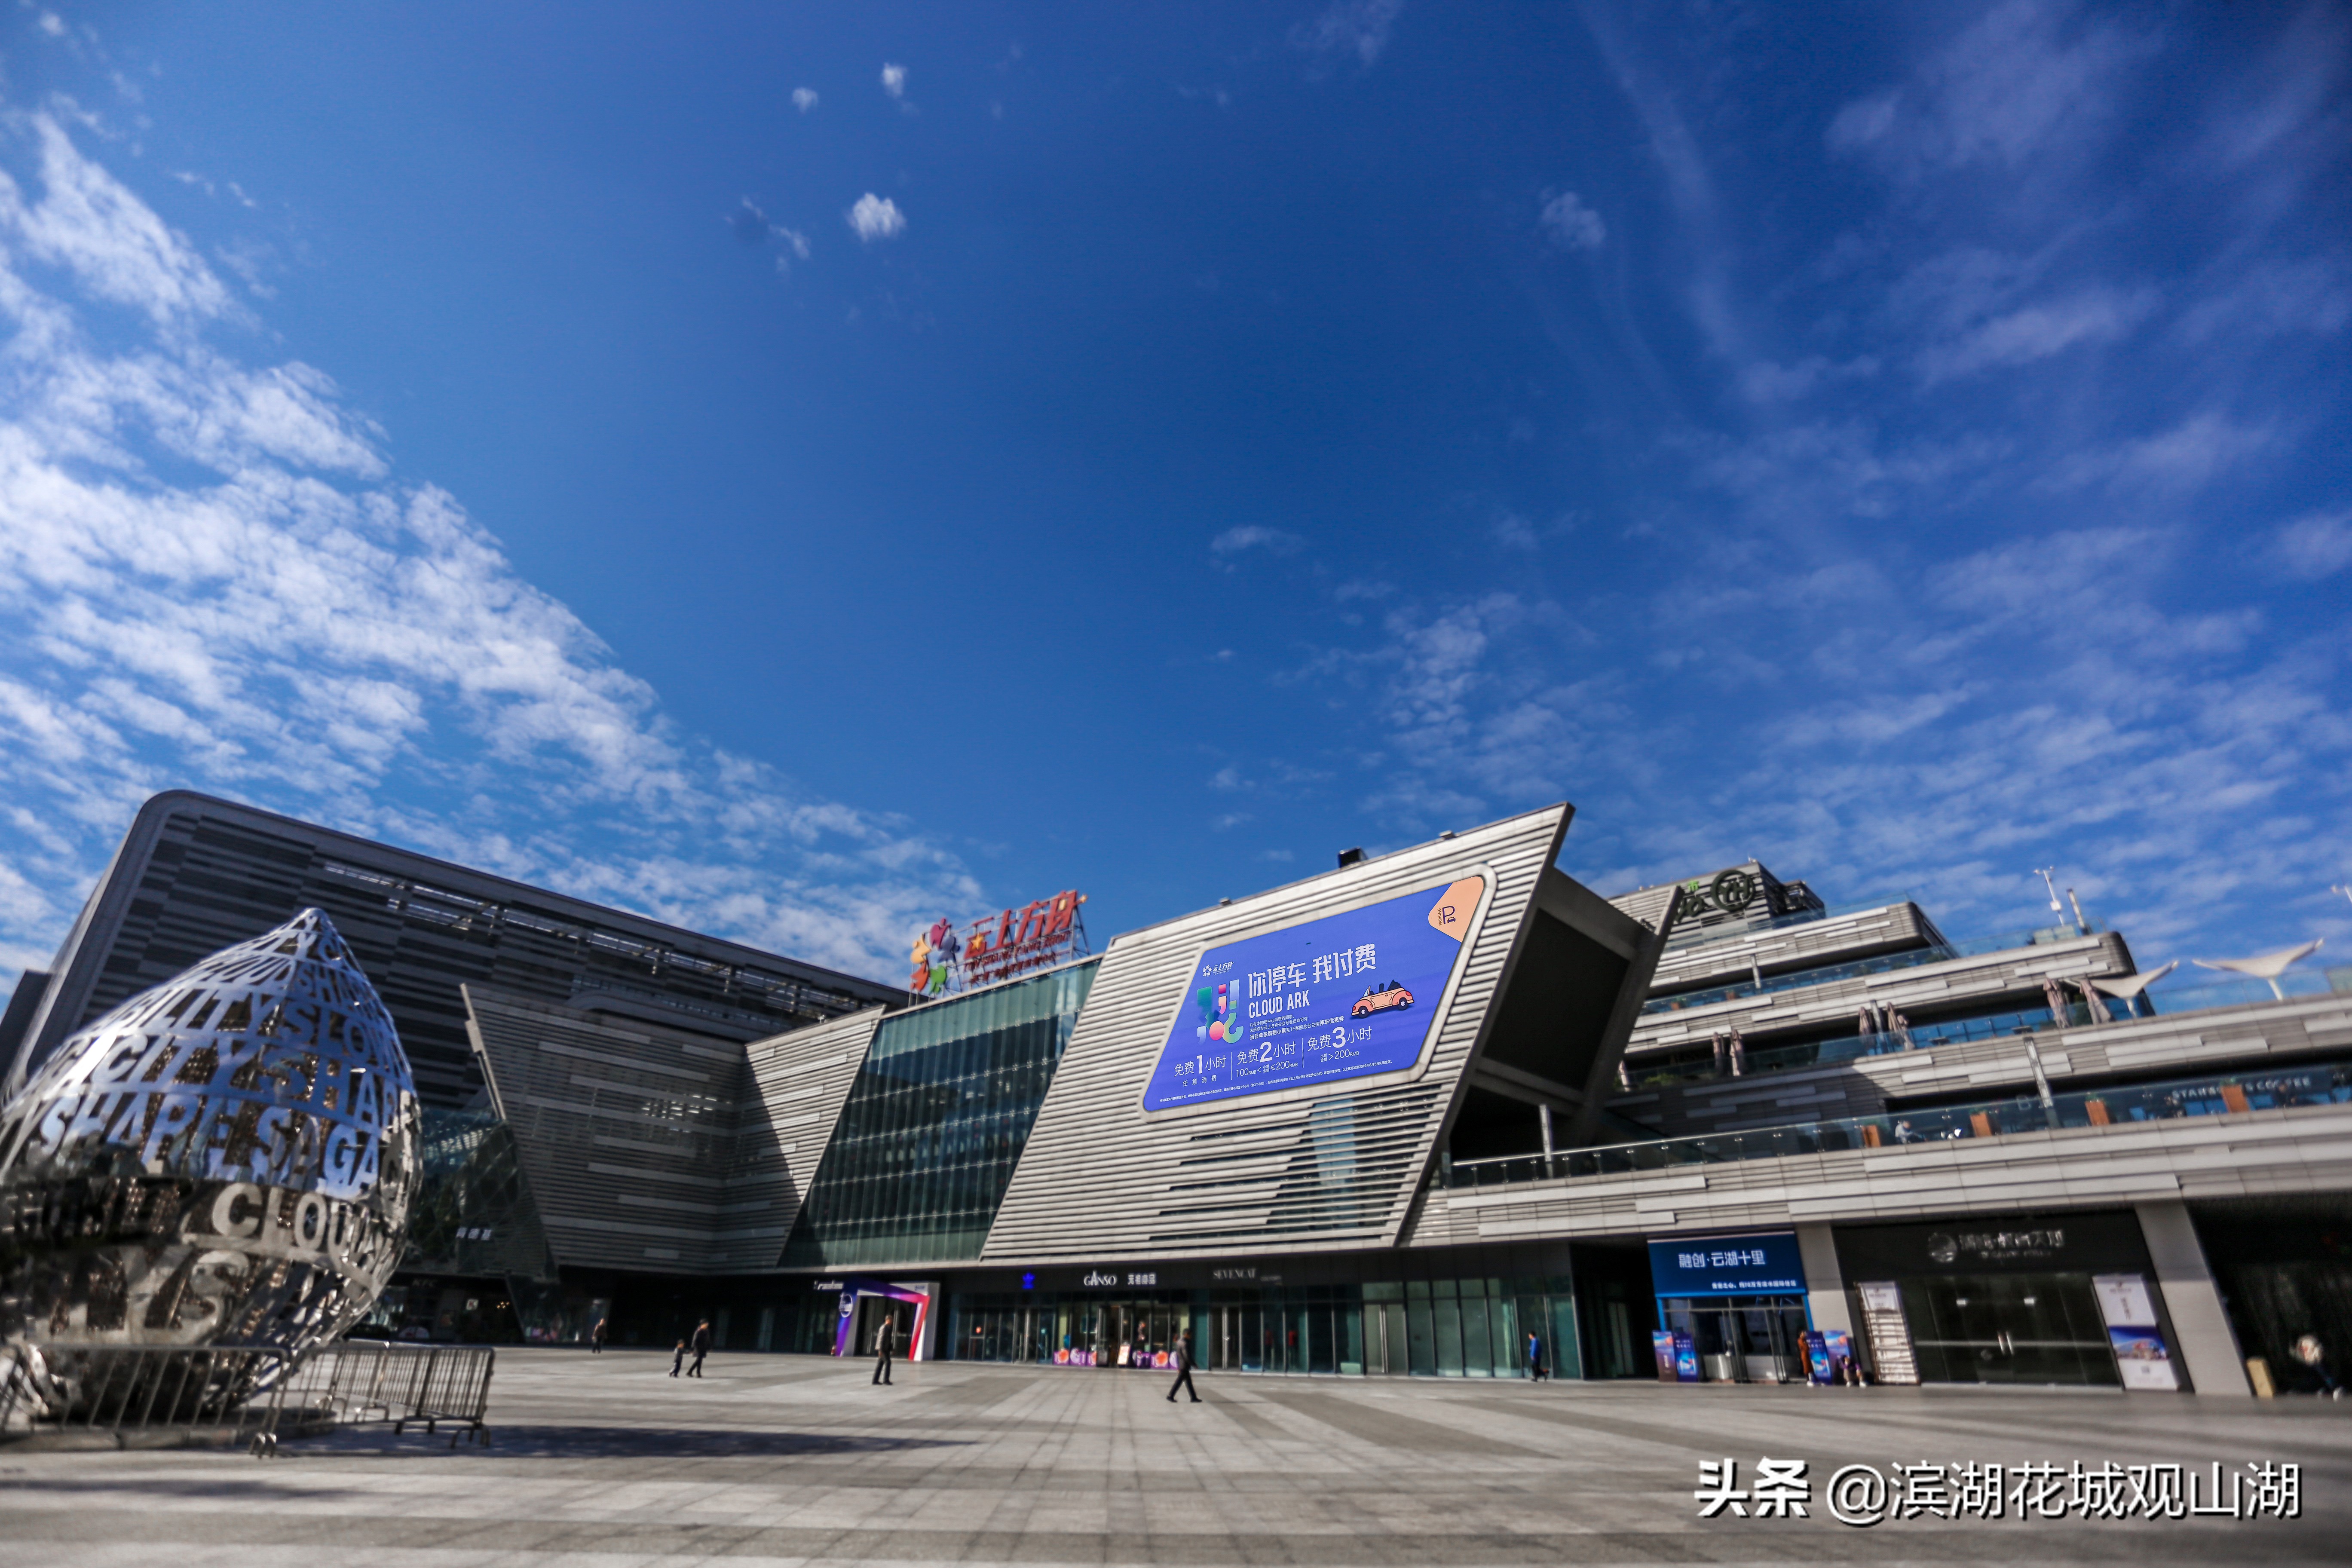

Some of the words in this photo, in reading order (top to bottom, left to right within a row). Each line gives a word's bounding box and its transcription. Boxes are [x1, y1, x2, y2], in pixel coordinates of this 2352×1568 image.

[1442, 906, 1455, 924] P
[1248, 962, 1306, 998] 你停车
[1312, 943, 1377, 984] 我付费
[1249, 995, 1283, 1019] CLOUD
[1287, 989, 1311, 1011] ARK
[1084, 1270, 1117, 1286] GANSO
